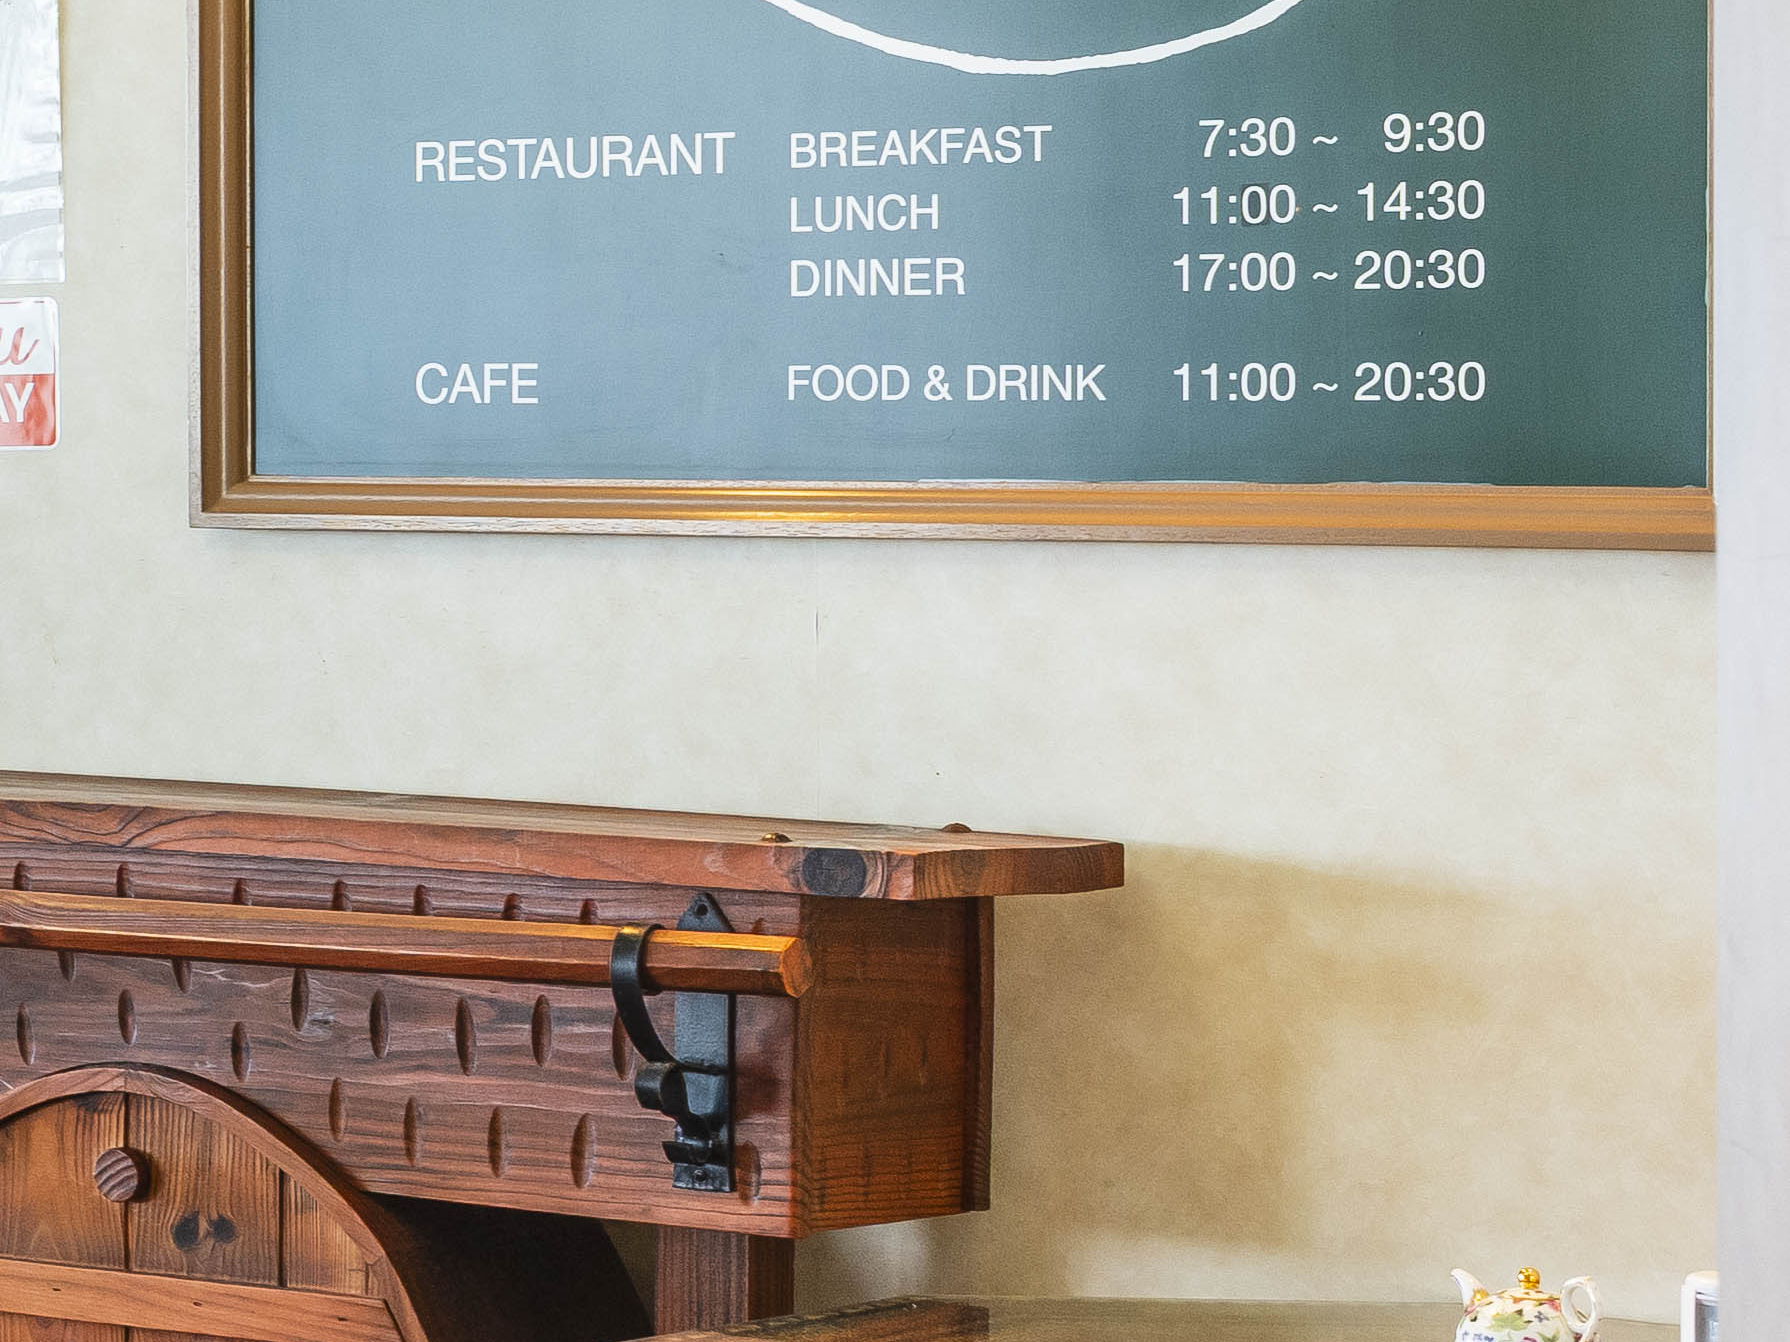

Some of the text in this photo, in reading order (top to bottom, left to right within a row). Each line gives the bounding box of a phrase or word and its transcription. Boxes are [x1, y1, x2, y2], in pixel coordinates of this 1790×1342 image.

[414, 130, 736, 185] RESTAURANT
[789, 123, 1054, 171] BREAKFAST
[1197, 115, 1299, 160] 7:30
[1382, 107, 1487, 155] 9:30
[789, 192, 942, 235] LUNCH
[1171, 181, 1299, 228] 11:00
[1354, 177, 1487, 224] 14:30
[789, 255, 967, 300] DINNER
[1171, 249, 1299, 294] 17:00
[1353, 245, 1487, 292] 20:30
[414, 362, 541, 407] CAFE
[786, 361, 912, 406] FOOD
[921, 361, 955, 405] &
[963, 360, 1108, 405] DRINK
[1171, 358, 1299, 405] 11:00
[1353, 356, 1487, 402] 20:30
